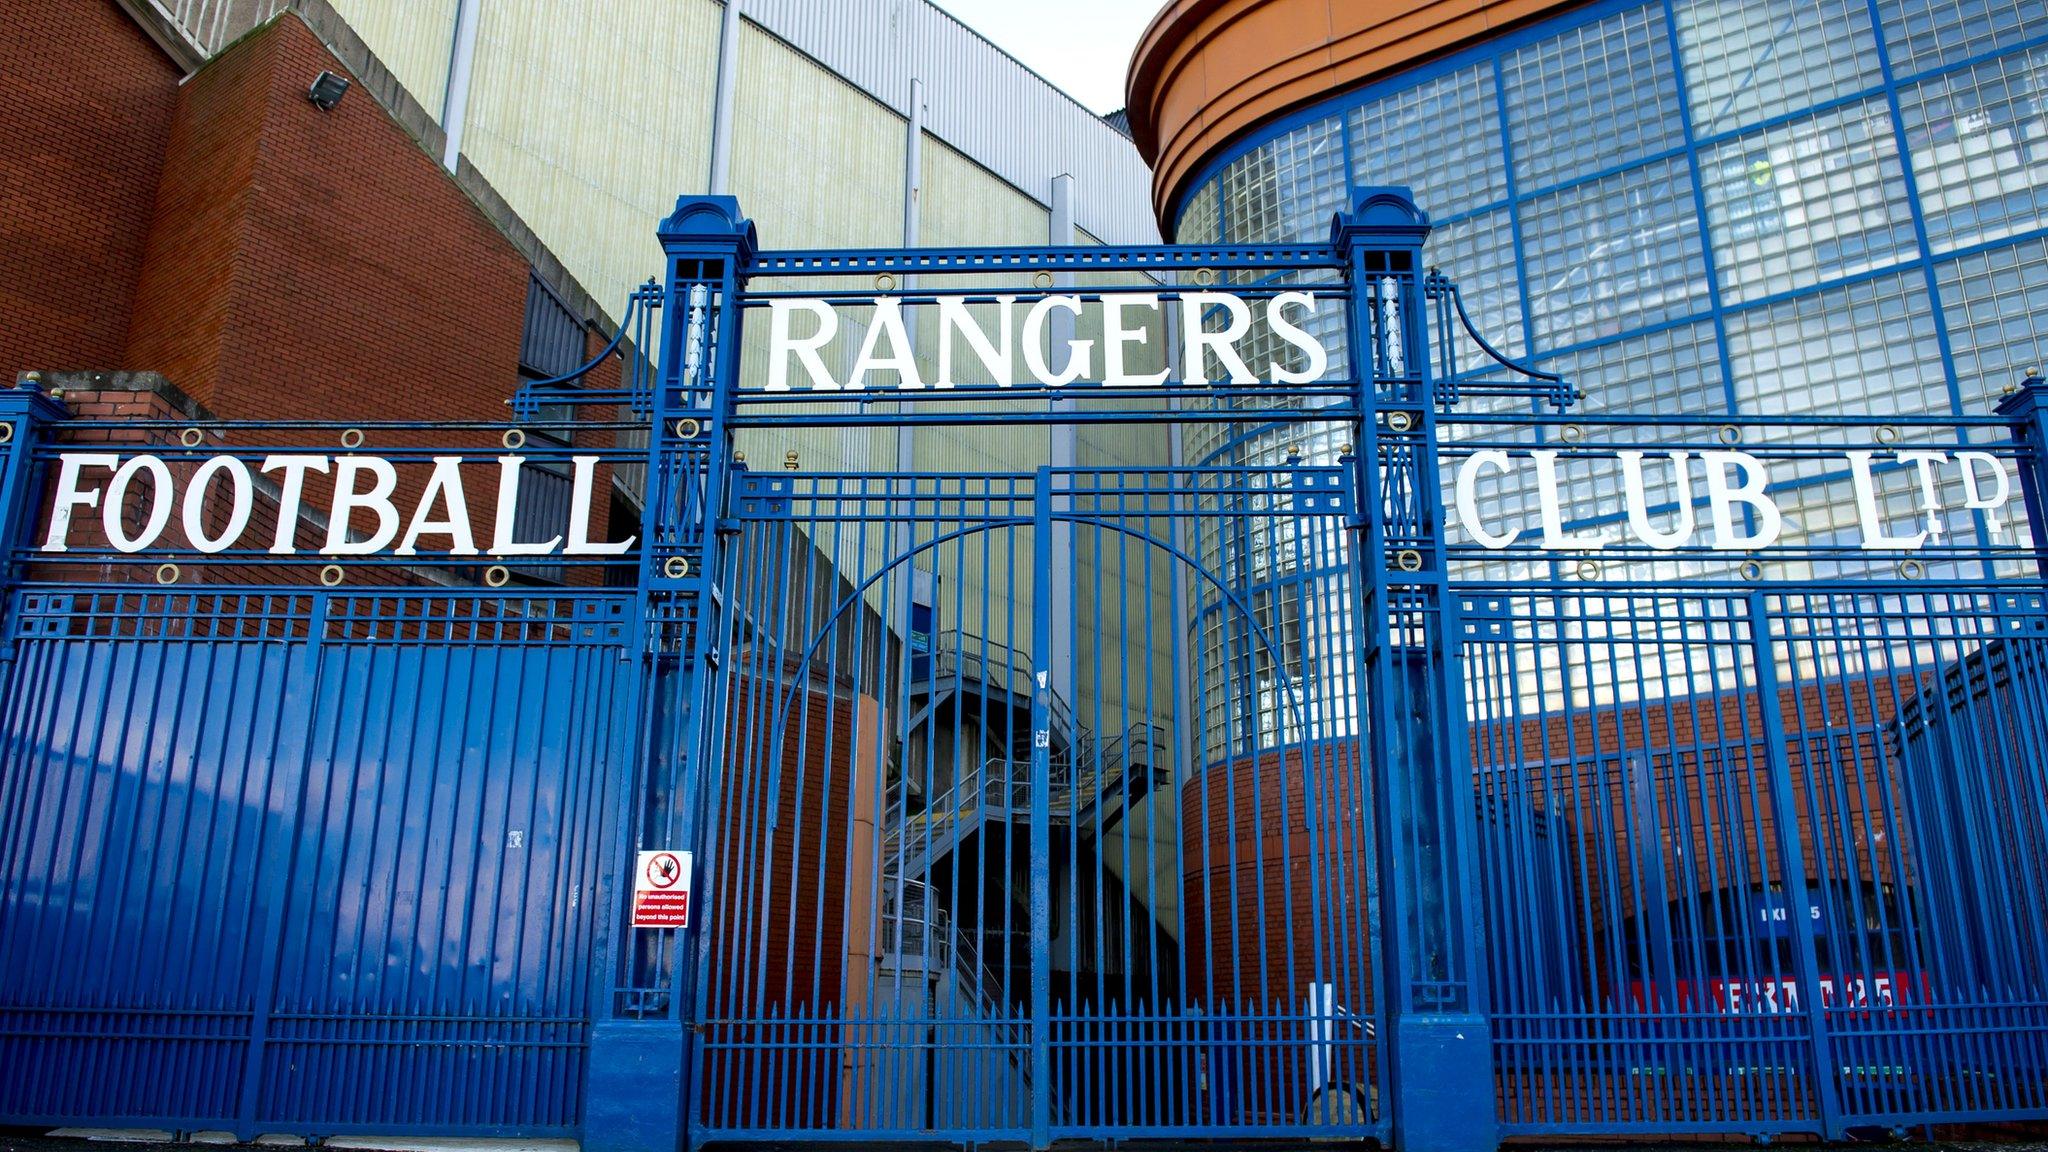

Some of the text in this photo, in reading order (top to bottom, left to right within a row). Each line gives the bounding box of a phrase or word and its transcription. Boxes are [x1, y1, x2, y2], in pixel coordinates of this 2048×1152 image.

[764, 291, 1328, 392] RANGERS
[41, 453, 637, 555] FOOTBALL
[1455, 450, 1783, 550] CLUB
